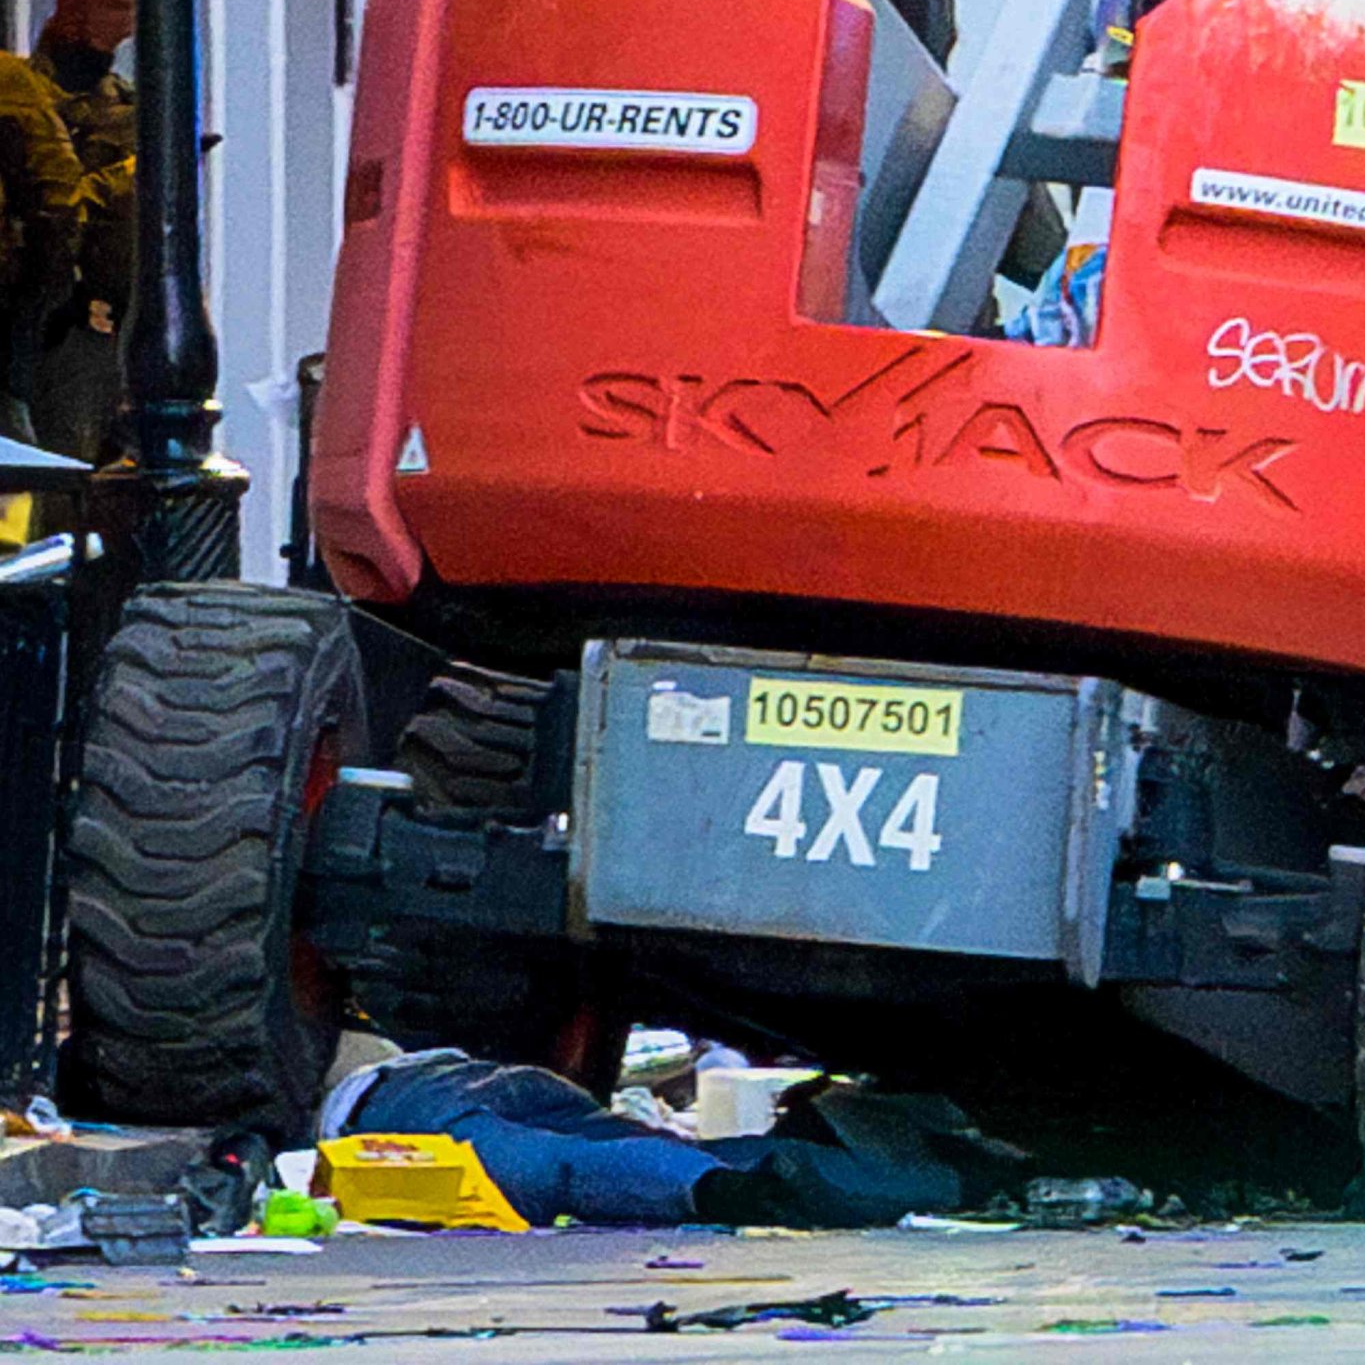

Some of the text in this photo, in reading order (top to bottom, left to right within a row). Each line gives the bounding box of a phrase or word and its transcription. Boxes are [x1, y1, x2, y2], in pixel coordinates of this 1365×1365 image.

[473, 101, 743, 139] 1-800-UR-RENTS
[751, 691, 953, 737] 10507501
[743, 759, 943, 872] 4X4
